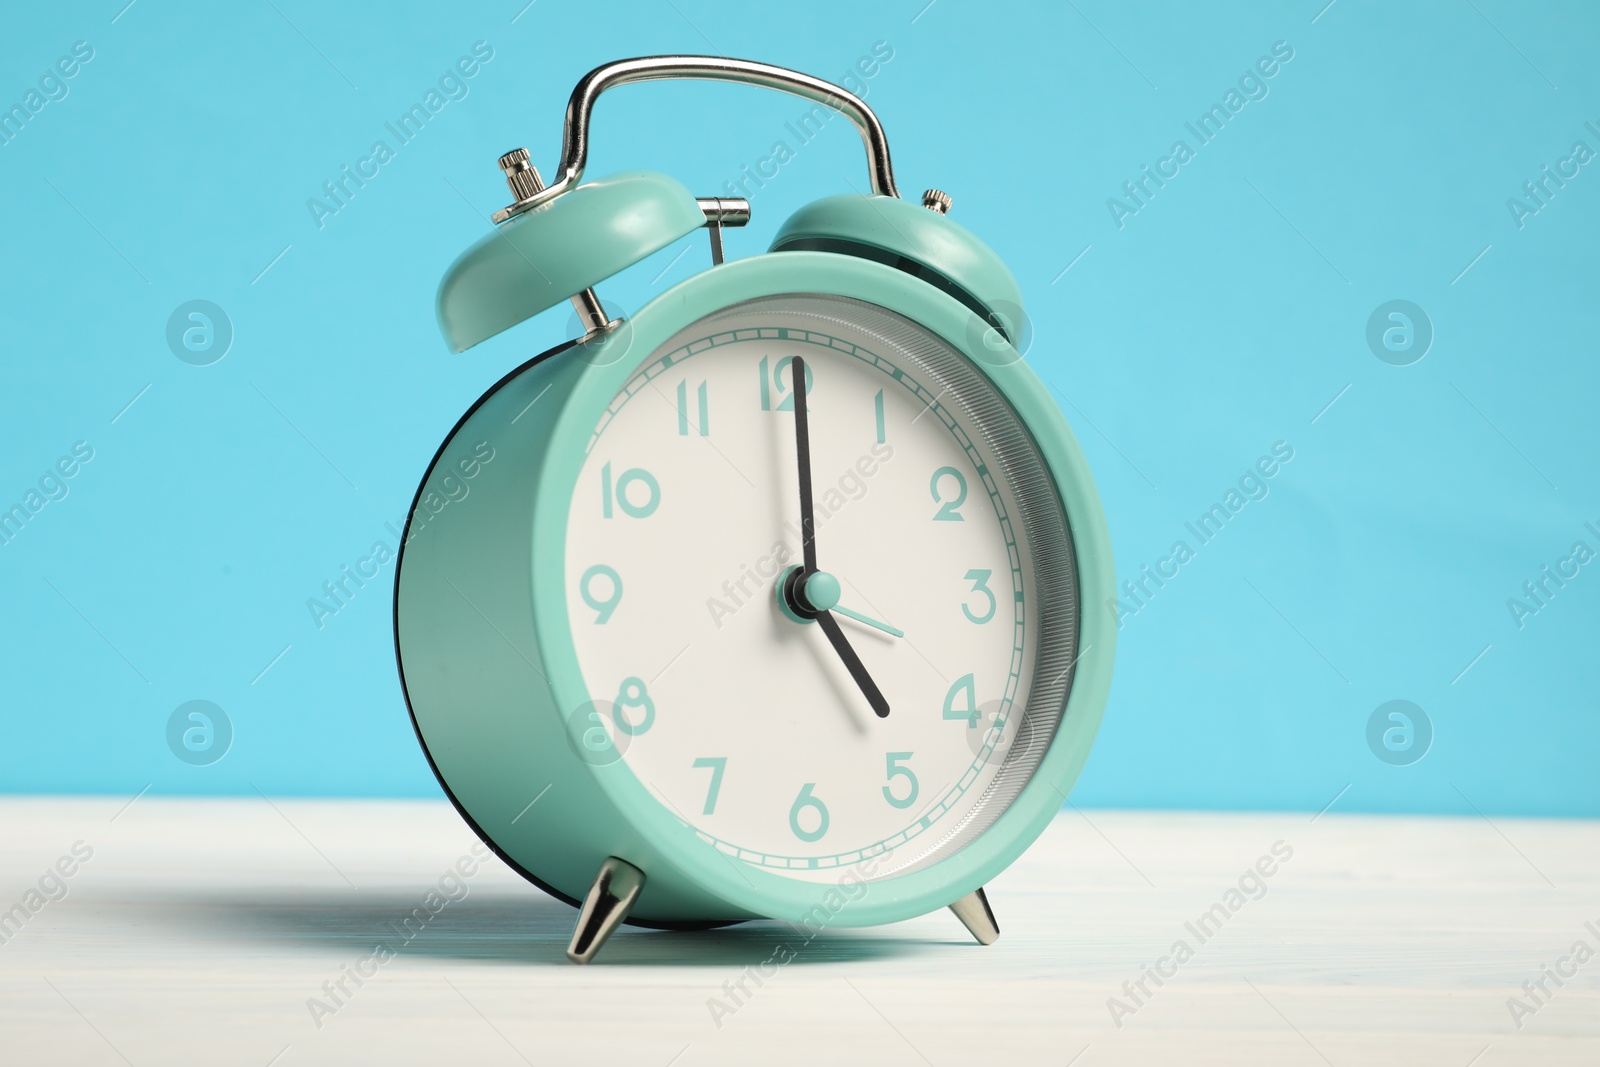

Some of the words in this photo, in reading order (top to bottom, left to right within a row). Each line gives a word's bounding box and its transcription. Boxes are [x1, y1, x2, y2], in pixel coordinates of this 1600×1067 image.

[677, 379, 710, 437] 11
[759, 354, 814, 412] 12
[874, 388, 887, 445] 1
[601, 461, 661, 520] 10
[930, 466, 968, 522] 2
[579, 564, 624, 625] 9
[961, 569, 997, 625] 3
[612, 677, 656, 737] 8
[942, 673, 983, 729] 4
[692, 757, 728, 816] 7
[882, 751, 920, 809] 5
[789, 783, 830, 843] 6
